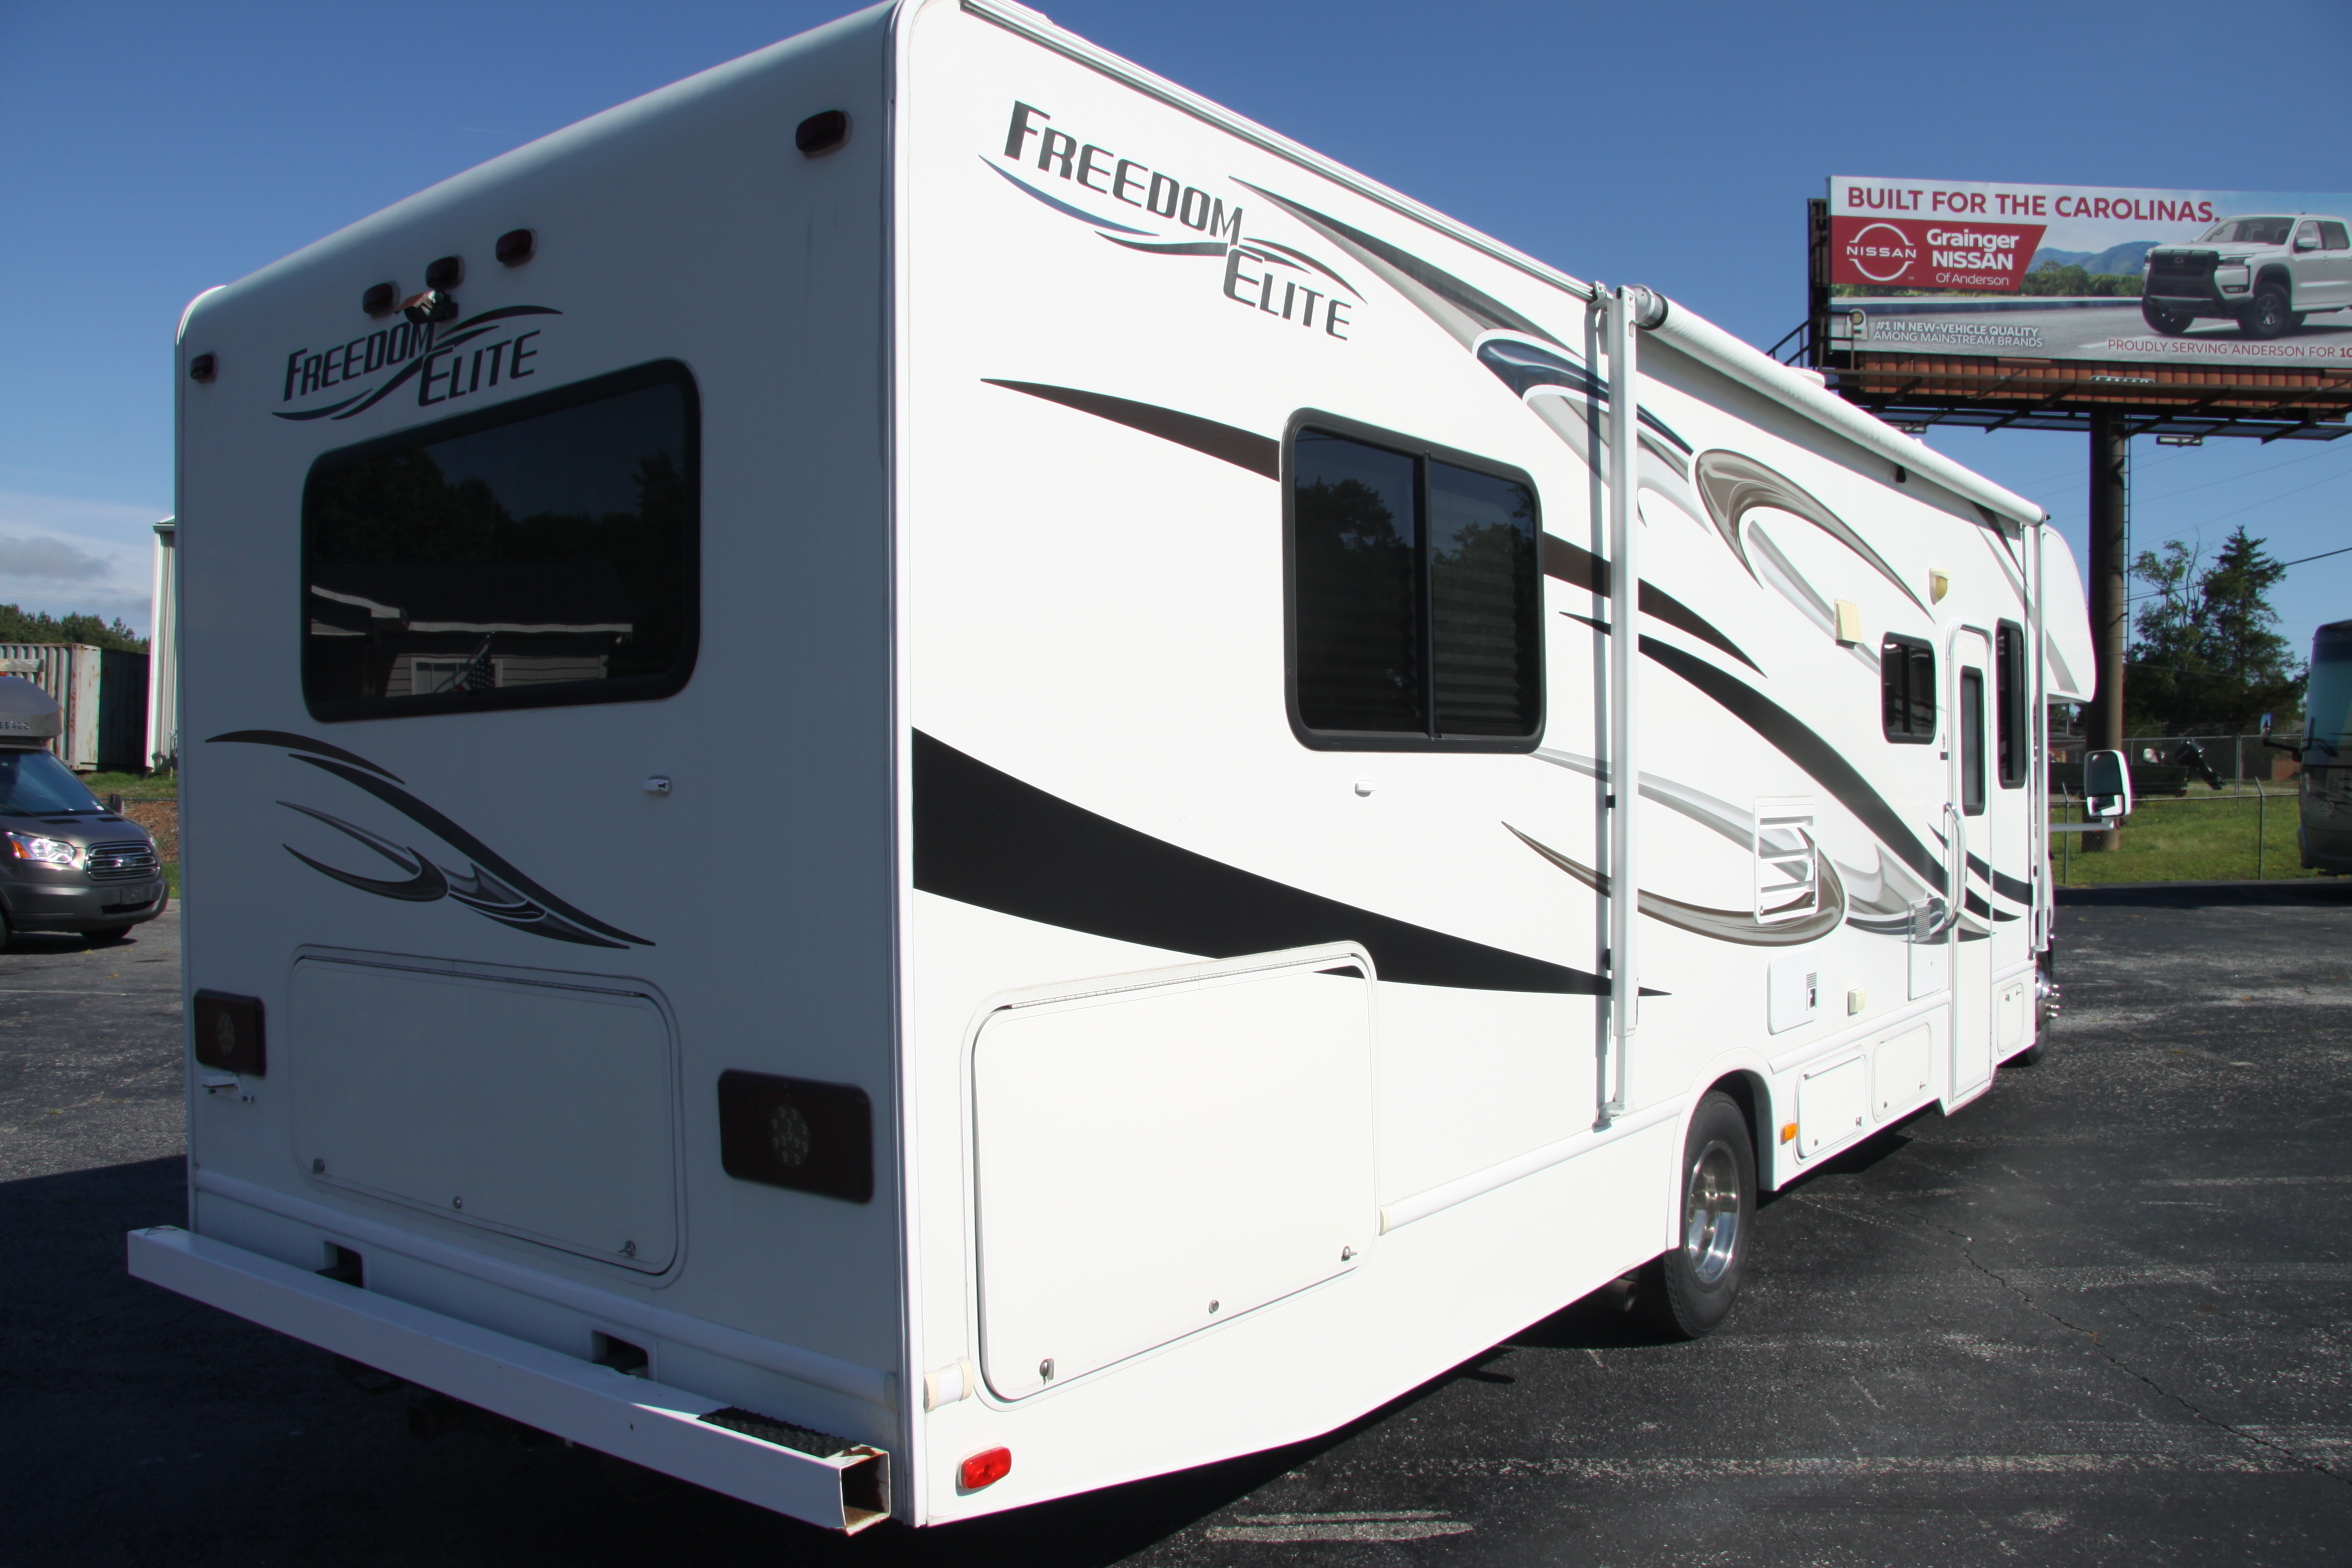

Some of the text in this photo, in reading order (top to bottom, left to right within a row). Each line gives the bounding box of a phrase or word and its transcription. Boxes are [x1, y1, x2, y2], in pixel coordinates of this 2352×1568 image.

[1004, 100, 1244, 246] FREEDOM
[1848, 186, 2221, 223] BUILT FOR THE CAROLINAS.
[1926, 228, 2020, 252] Grainger
[1846, 245, 1917, 259] NISSAN
[1932, 251, 2013, 270] NISSAN
[1935, 272, 2009, 286] Of Anderson
[1223, 248, 1353, 342] ELITE
[1873, 331, 2043, 348] AMONG MAINSTREAM BRANDS
[1876, 321, 2039, 337] #1 IN NEW-VEHICLE QUALITY
[2108, 339, 2168, 352] PROUDLY
[2171, 342, 2228, 355] SERVING
[2231, 344, 2305, 357] ANDERSON
[2309, 346, 2335, 358] FOR
[283, 321, 436, 402] FREEDOM
[418, 330, 541, 407] ELITE
